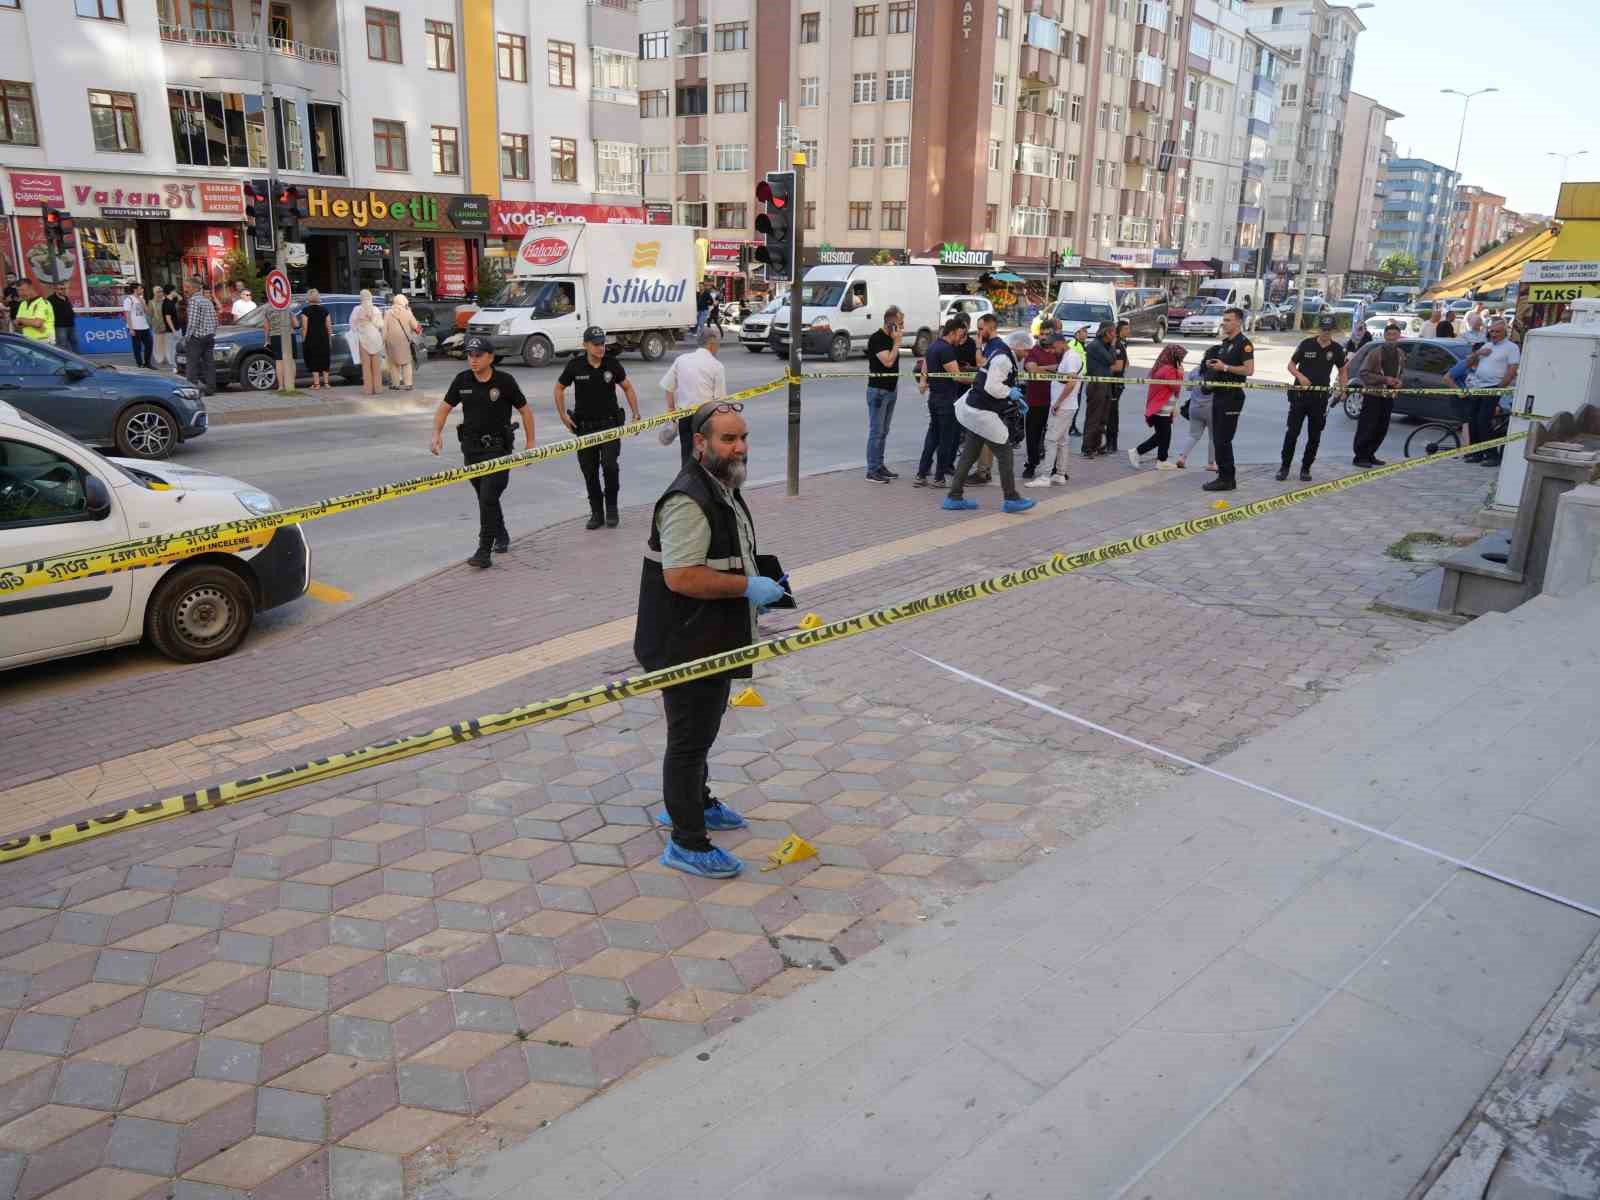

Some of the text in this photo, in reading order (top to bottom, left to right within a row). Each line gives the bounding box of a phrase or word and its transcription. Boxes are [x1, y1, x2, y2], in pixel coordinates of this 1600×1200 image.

[72, 185, 160, 206] Vatan
[307, 188, 440, 227] Heybetli
[602, 277, 687, 304] istikbal
[1534, 286, 1582, 300] TAKSİ
[85, 327, 128, 343] pepsi
[783, 842, 793, 854] 2
